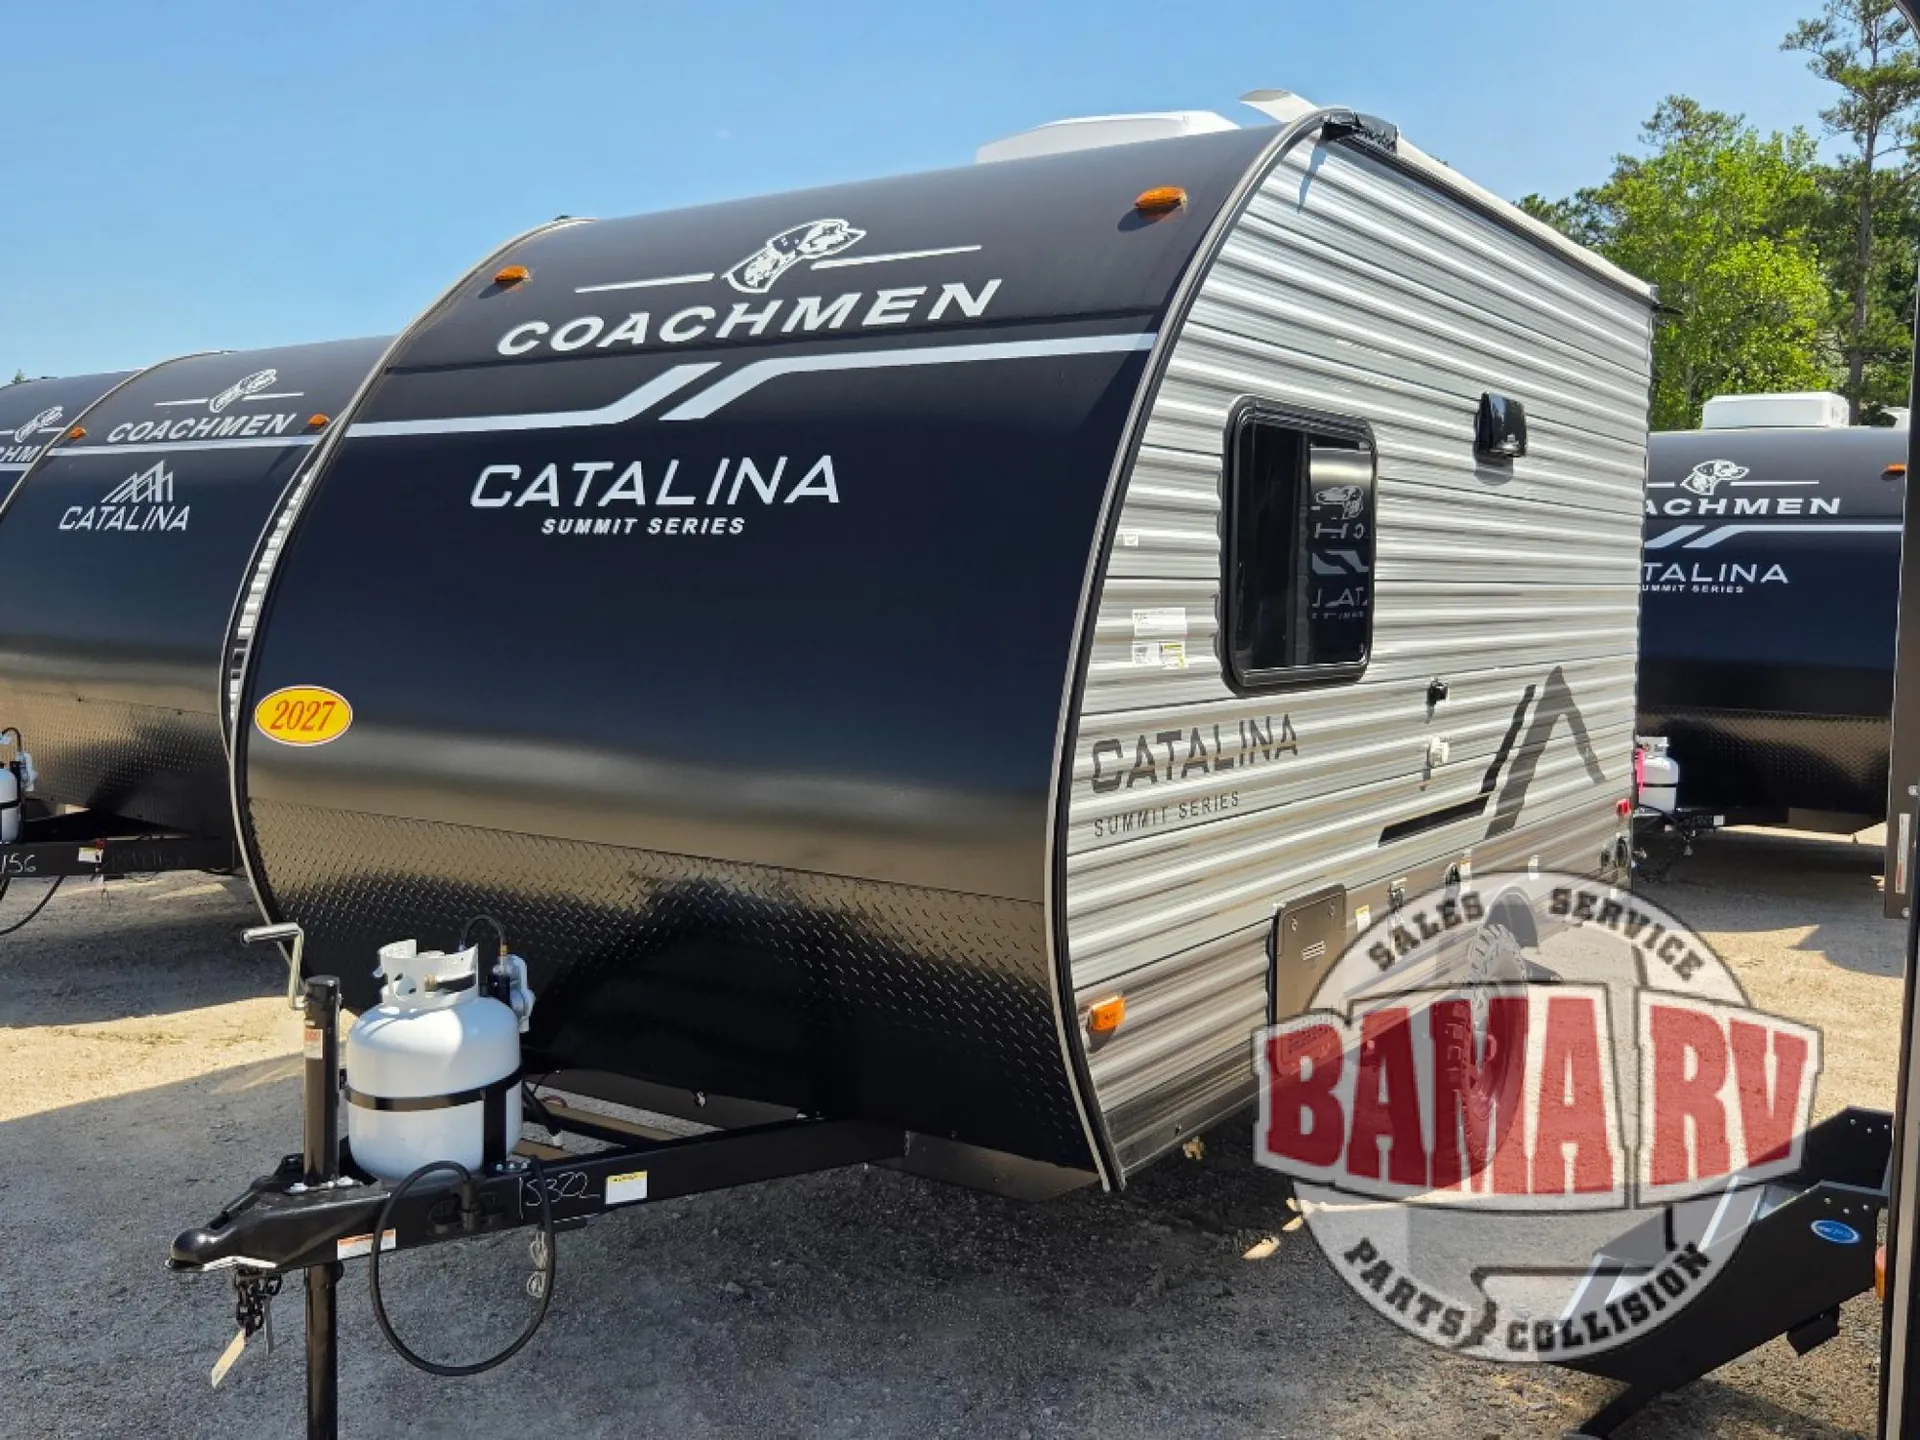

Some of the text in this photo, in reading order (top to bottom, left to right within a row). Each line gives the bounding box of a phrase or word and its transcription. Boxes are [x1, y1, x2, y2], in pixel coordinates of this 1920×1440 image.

[497, 278, 1001, 355] COACHMEN
[107, 413, 297, 443] COACHMEN
[470, 455, 840, 509] CATALINA
[58, 505, 190, 532] CATALINA
[541, 516, 746, 535] SUMMIT SERIES
[1691, 584, 1744, 594] SERIES
[269, 700, 337, 731] 2027
[1092, 713, 1298, 794] CATALINA
[1094, 790, 1239, 838] SUMMIT SERIES
